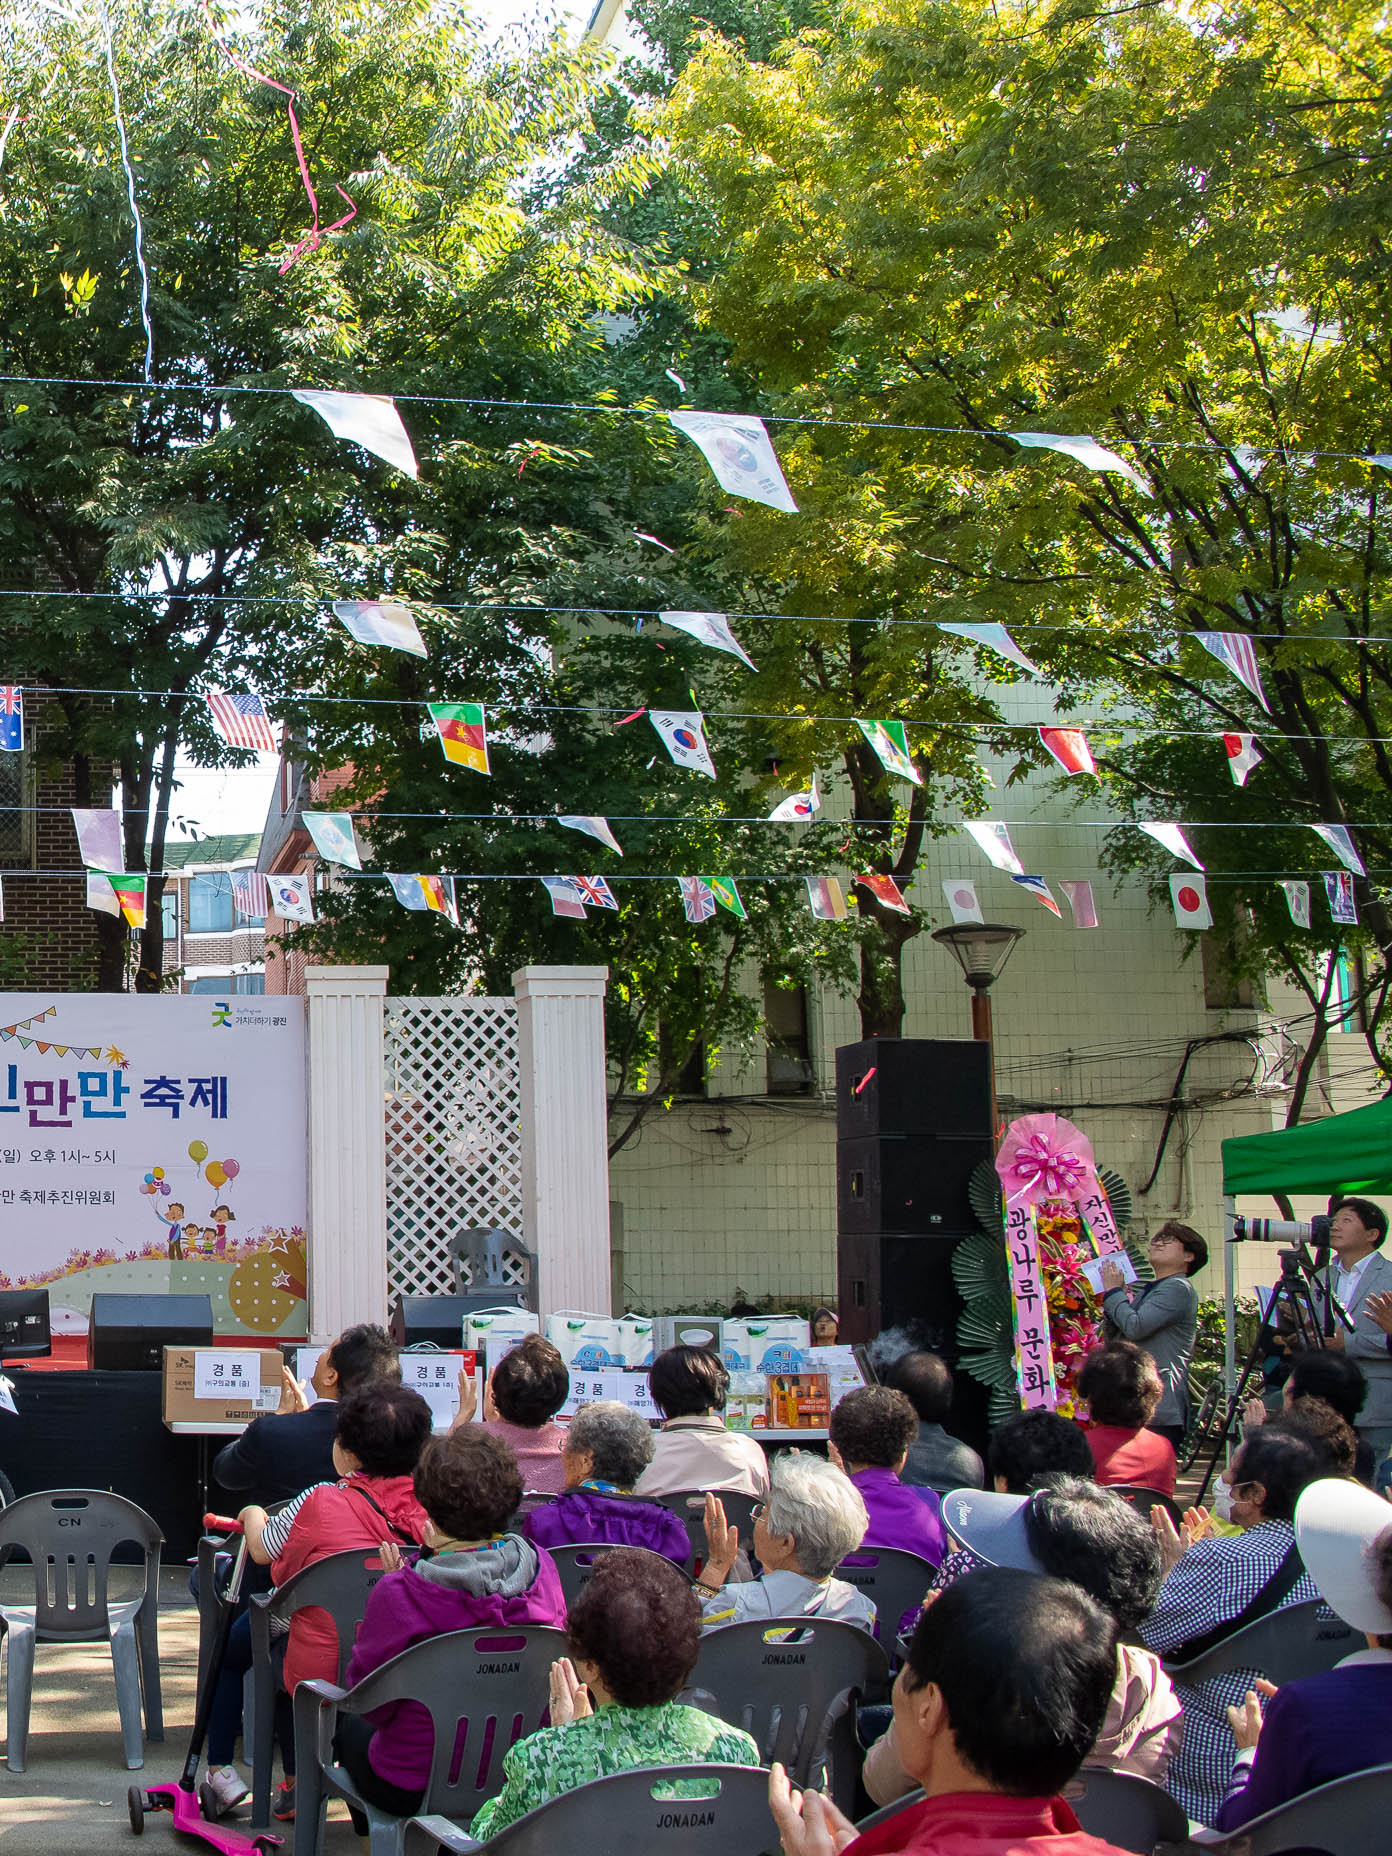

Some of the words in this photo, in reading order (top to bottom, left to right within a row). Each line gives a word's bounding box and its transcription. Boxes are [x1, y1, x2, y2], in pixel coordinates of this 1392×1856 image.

[235, 1016, 271, 1025] 가치더하기
[272, 1016, 287, 1026] 광진
[140, 1075, 228, 1119] 축제
[29, 1149, 57, 1164] 오후
[94, 1149, 116, 1164] 5시
[18, 1189, 116, 1205] 축제추진위원회
[1084, 1194, 1121, 1255] 자신만
[1008, 1207, 1040, 1314] 광나루
[1020, 1326, 1050, 1409] 문화
[58, 1518, 81, 1527] CN
[761, 1654, 807, 1665] JONADAN
[476, 1662, 521, 1675] JONADAN
[656, 1812, 715, 1830] JONADAN
